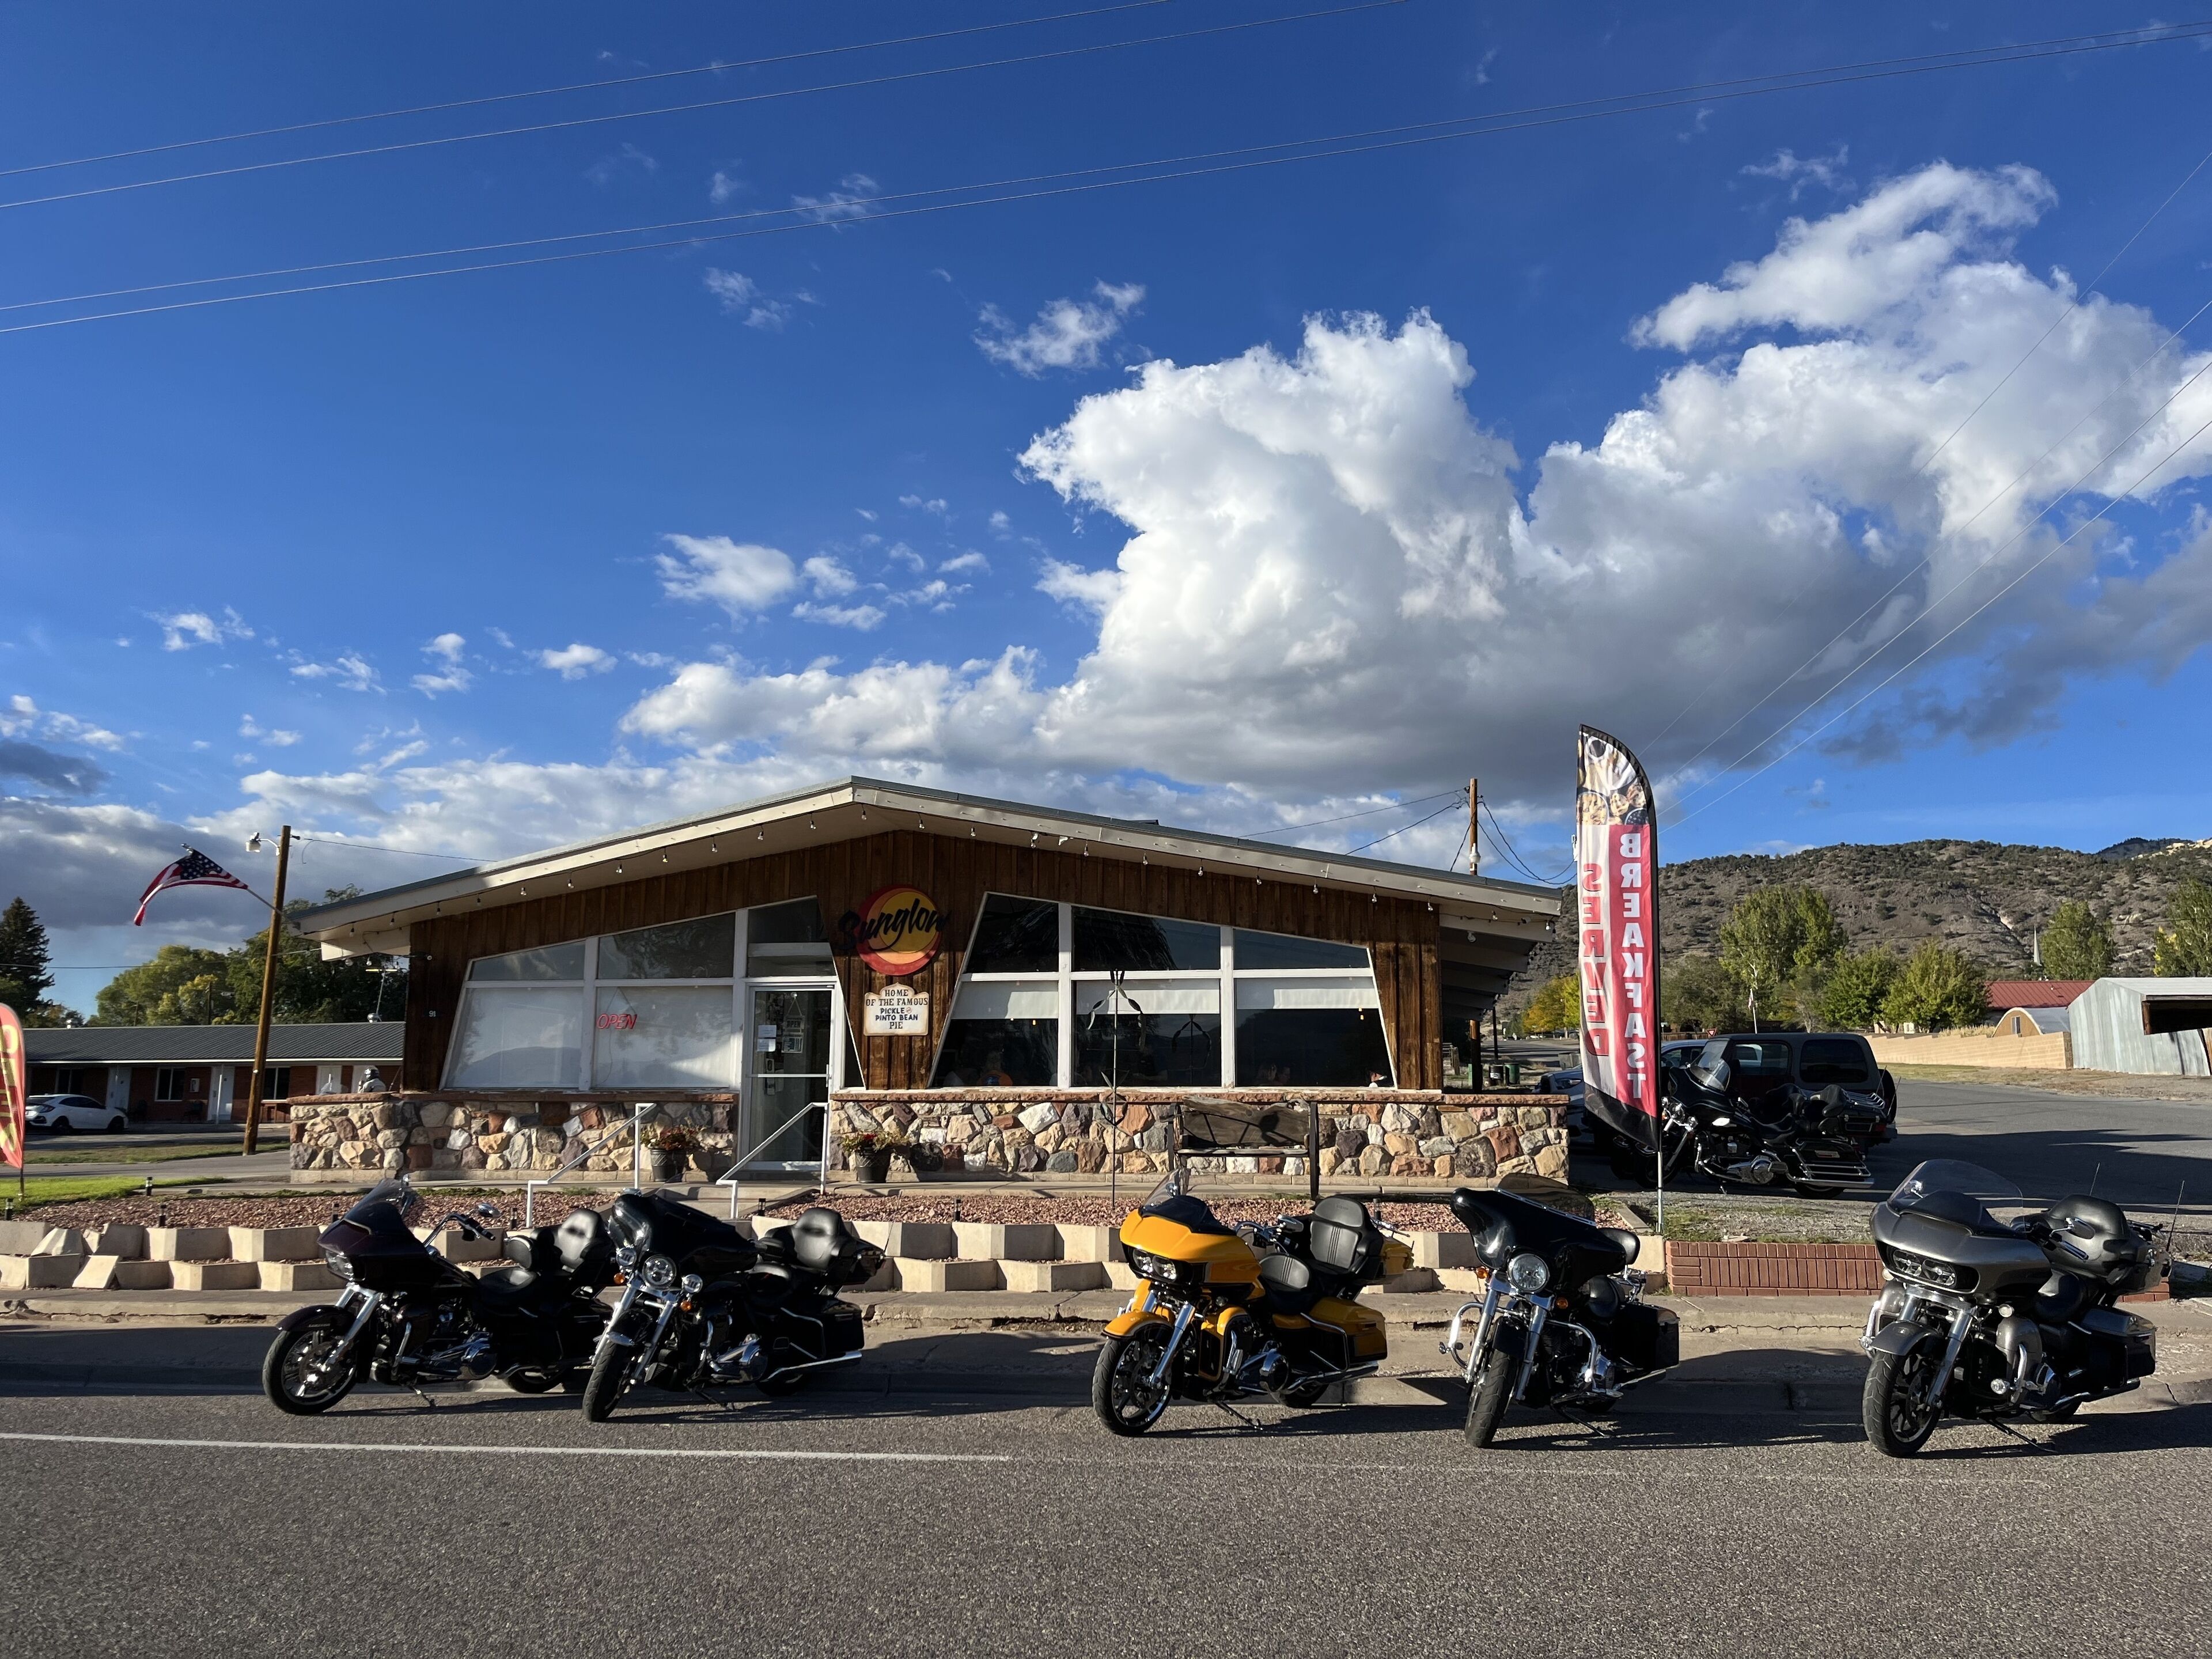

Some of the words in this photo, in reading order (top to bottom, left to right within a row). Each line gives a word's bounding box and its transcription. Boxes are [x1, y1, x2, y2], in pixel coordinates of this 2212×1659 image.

[839, 898, 950, 950] Sunglow
[897, 998, 928, 1006] FAMOUS
[597, 1014, 637, 1029] OPEN
[787, 1020, 801, 1028] OPEN
